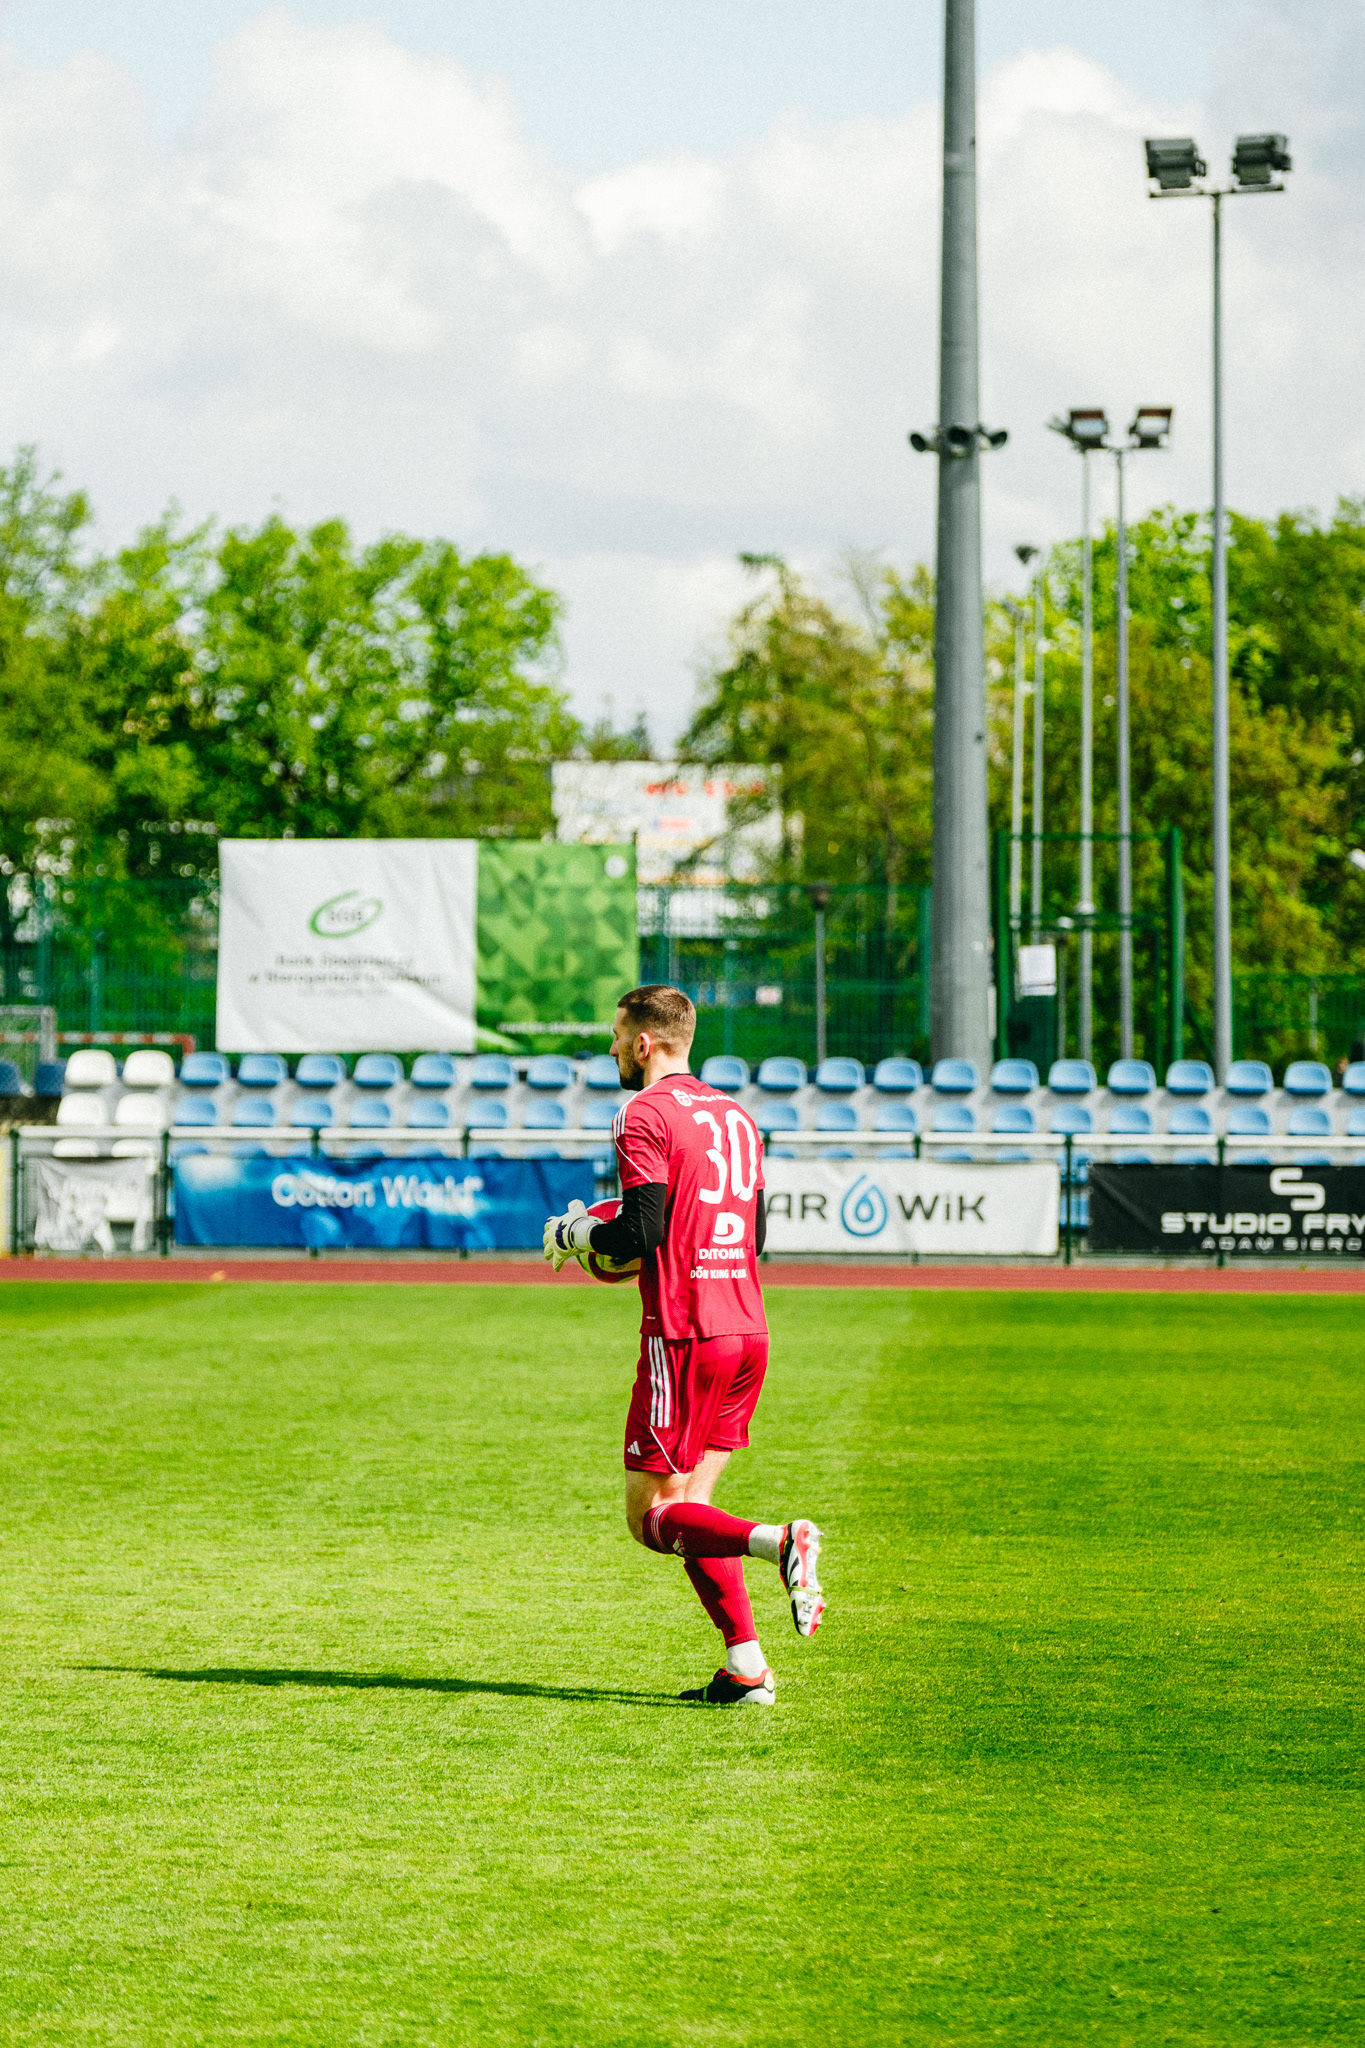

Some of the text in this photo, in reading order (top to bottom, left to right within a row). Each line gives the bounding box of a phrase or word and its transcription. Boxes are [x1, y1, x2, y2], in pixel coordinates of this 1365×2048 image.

[692, 1109, 757, 1205] 30
[271, 1173, 376, 1208] Cotton
[1161, 1212, 1292, 1235] STUDIO
[1201, 1236, 1275, 1251] ADAM
